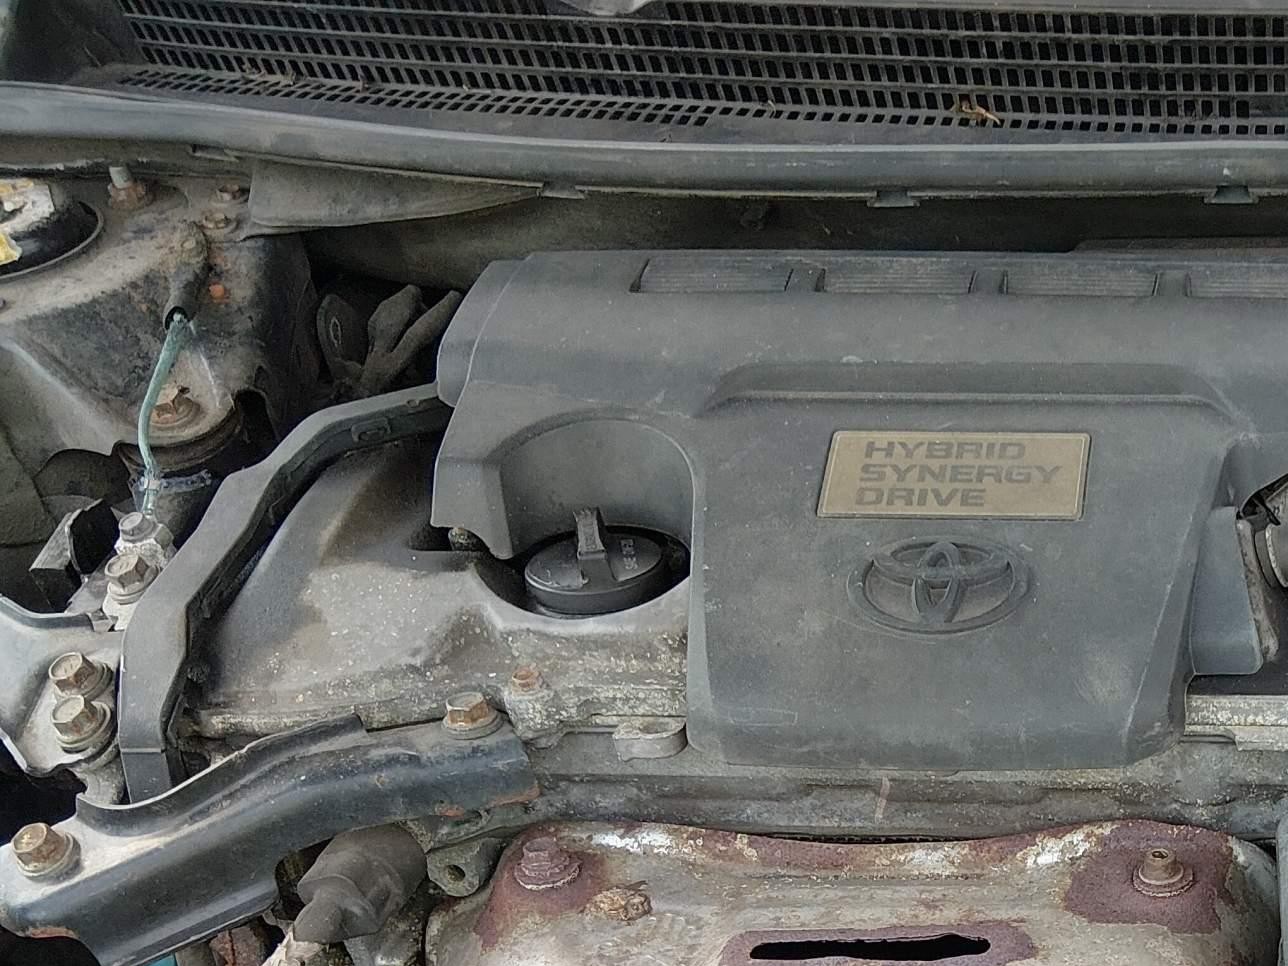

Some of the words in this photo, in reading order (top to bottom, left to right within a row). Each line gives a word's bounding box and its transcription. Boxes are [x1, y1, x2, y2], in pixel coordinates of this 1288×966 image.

[864, 441, 1027, 460] HYBRID
[859, 464, 1062, 484] SYNERGY
[855, 487, 987, 507] DRIVE
